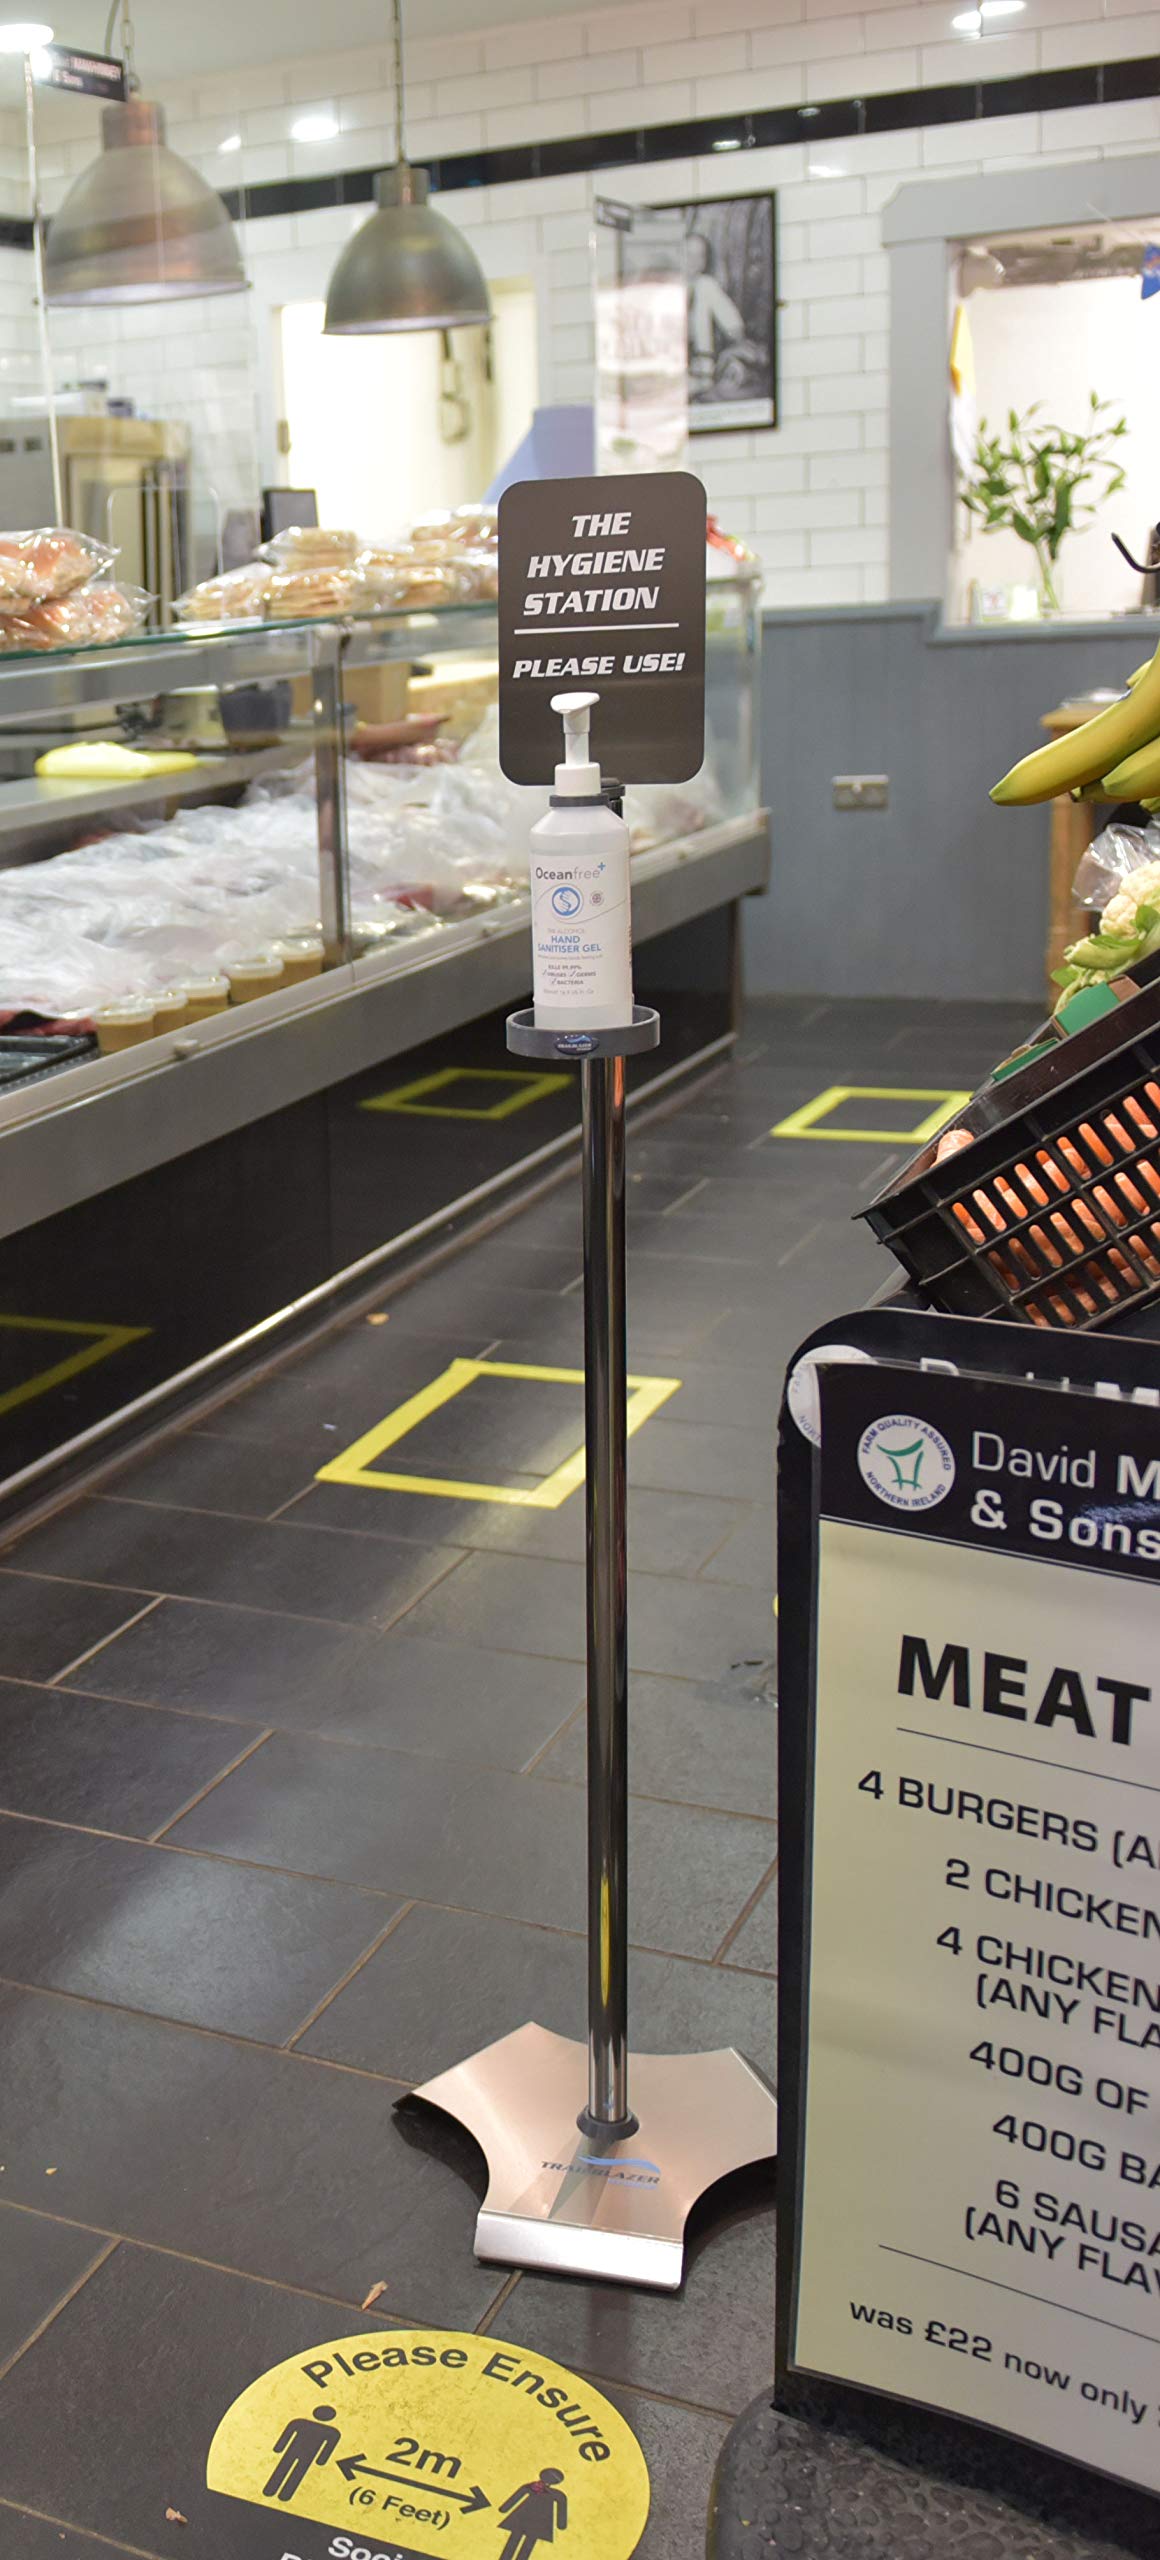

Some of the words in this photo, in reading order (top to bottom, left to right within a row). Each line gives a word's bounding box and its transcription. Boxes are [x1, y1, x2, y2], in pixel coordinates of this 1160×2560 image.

[572, 512, 632, 538] THE
[527, 548, 666, 579] HYGIENE
[523, 586, 660, 616] STATION
[512, 656, 615, 679] PLEASE
[622, 652, 686, 674] USE!
[537, 944, 580, 954] SANITISER
[582, 943, 602, 952] GEL
[551, 935, 581, 944] HAND
[862, 1429, 879, 1455] FARM
[877, 1418, 920, 1432] QUALITY
[921, 1426, 952, 1471] ASSURED
[972, 1430, 1096, 1489] David
[866, 1471, 910, 1507] NORTHERN
[911, 1483, 947, 1507] IRELAND
[970, 1489, 1008, 1530] &
[1029, 1499, 1160, 1560] Sons
[898, 1633, 1152, 1747] MEAT
[858, 1770, 884, 1800] 4
[898, 1776, 1098, 1852] BURGERS
[1113, 1830, 1160, 1870] (A
[945, 1858, 971, 1890] 2
[985, 1868, 1160, 1940] CHICKEN
[936, 1926, 963, 1956] 4
[976, 1935, 1160, 2013] CHICKEN
[977, 1973, 1080, 2025] (ANY
[1093, 2005, 1160, 2049] FLA
[969, 2041, 1083, 2096] 400G
[1096, 2078, 1150, 2115] OF
[993, 2114, 1106, 2171] 400G
[996, 2179, 1020, 2210] 6
[965, 2206, 1065, 2260] (ANY
[1078, 2243, 1160, 2294] FLA
[850, 2301, 914, 2335] was
[925, 2320, 993, 2362] £22
[1004, 2352, 1070, 2389] now
[1080, 2381, 1147, 2424] only
[300, 2346, 469, 2389] Please
[481, 2357, 611, 2463] Ensure
[385, 2436, 463, 2480] 2m
[349, 2486, 377, 2506] (6
[381, 2494, 451, 2531] Feet)
